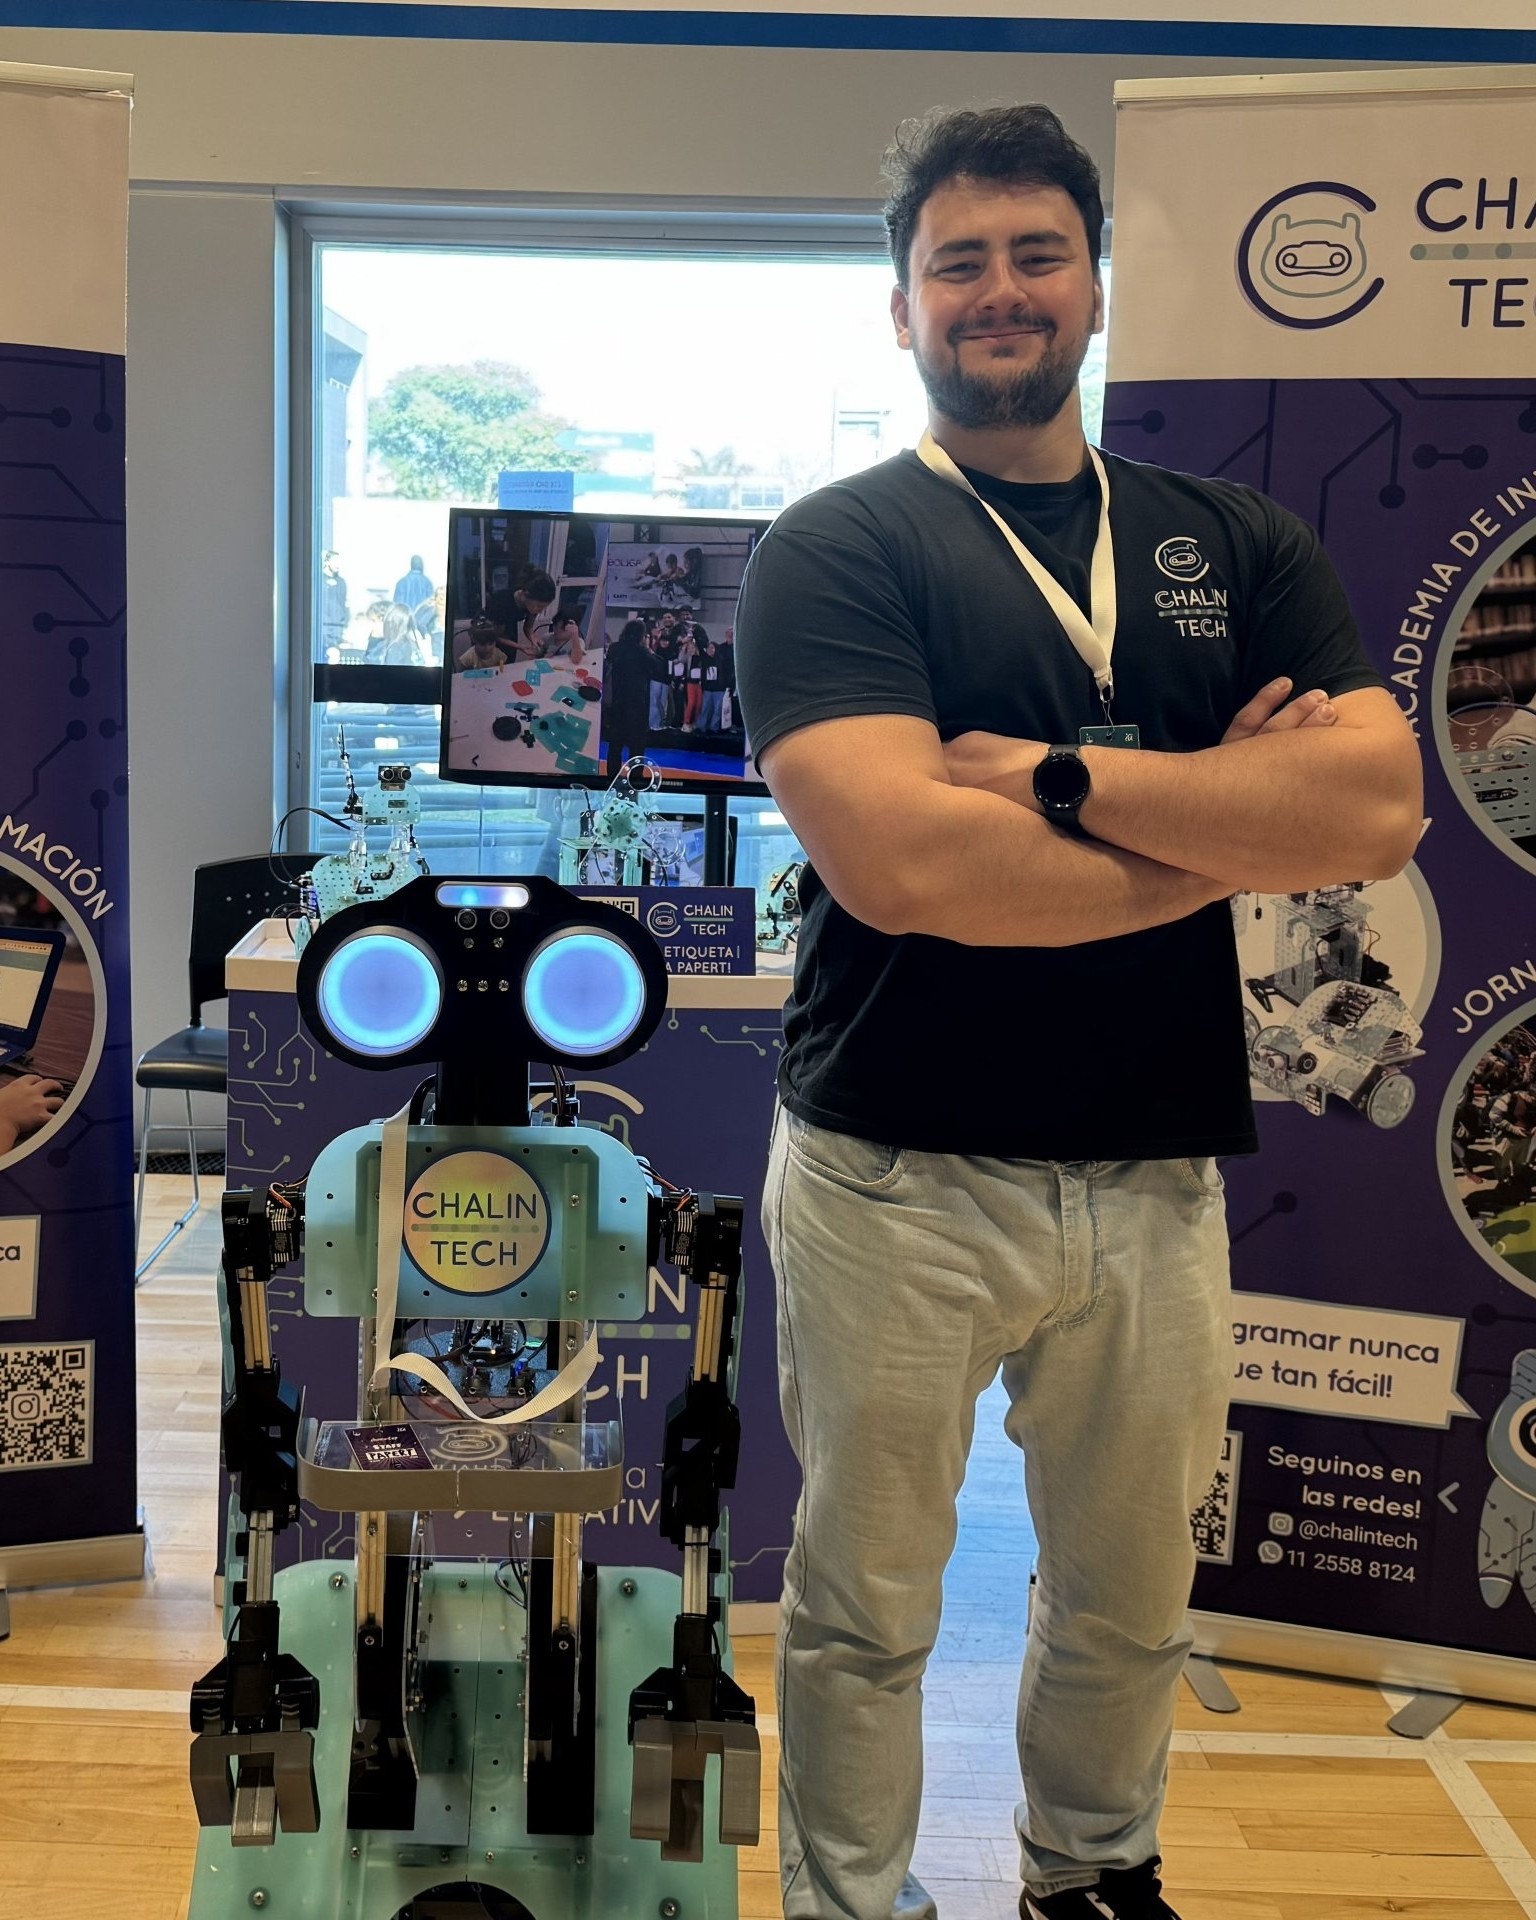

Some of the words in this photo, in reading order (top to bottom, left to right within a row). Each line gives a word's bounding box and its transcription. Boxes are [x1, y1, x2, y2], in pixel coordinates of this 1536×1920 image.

[1450, 508, 1500, 557] DE
[1175, 618, 1226, 637] TECH
[683, 904, 733, 917] CHALIN
[690, 923, 726, 936] TECH
[664, 946, 734, 960] ETIQUETA
[677, 961, 731, 974] PAPERT!
[412, 1192, 537, 1219] CHALIN
[430, 1240, 517, 1267] TECH
[1349, 1336, 1440, 1365] nunca
[1271, 1360, 1317, 1389] tan
[1328, 1369, 1393, 1398] fácil!
[370, 1449, 415, 1461] PAPERT
[1268, 1446, 1384, 1480] Seguinos
[1391, 1468, 1422, 1485] en
[1302, 1484, 1336, 1507] las
[1342, 1494, 1422, 1519] redes!
[1299, 1519, 1418, 1551] @chalintech
[1287, 1550, 1305, 1567] 11
[1314, 1553, 1363, 1575] 2558
[1368, 1561, 1416, 1583] 8124
